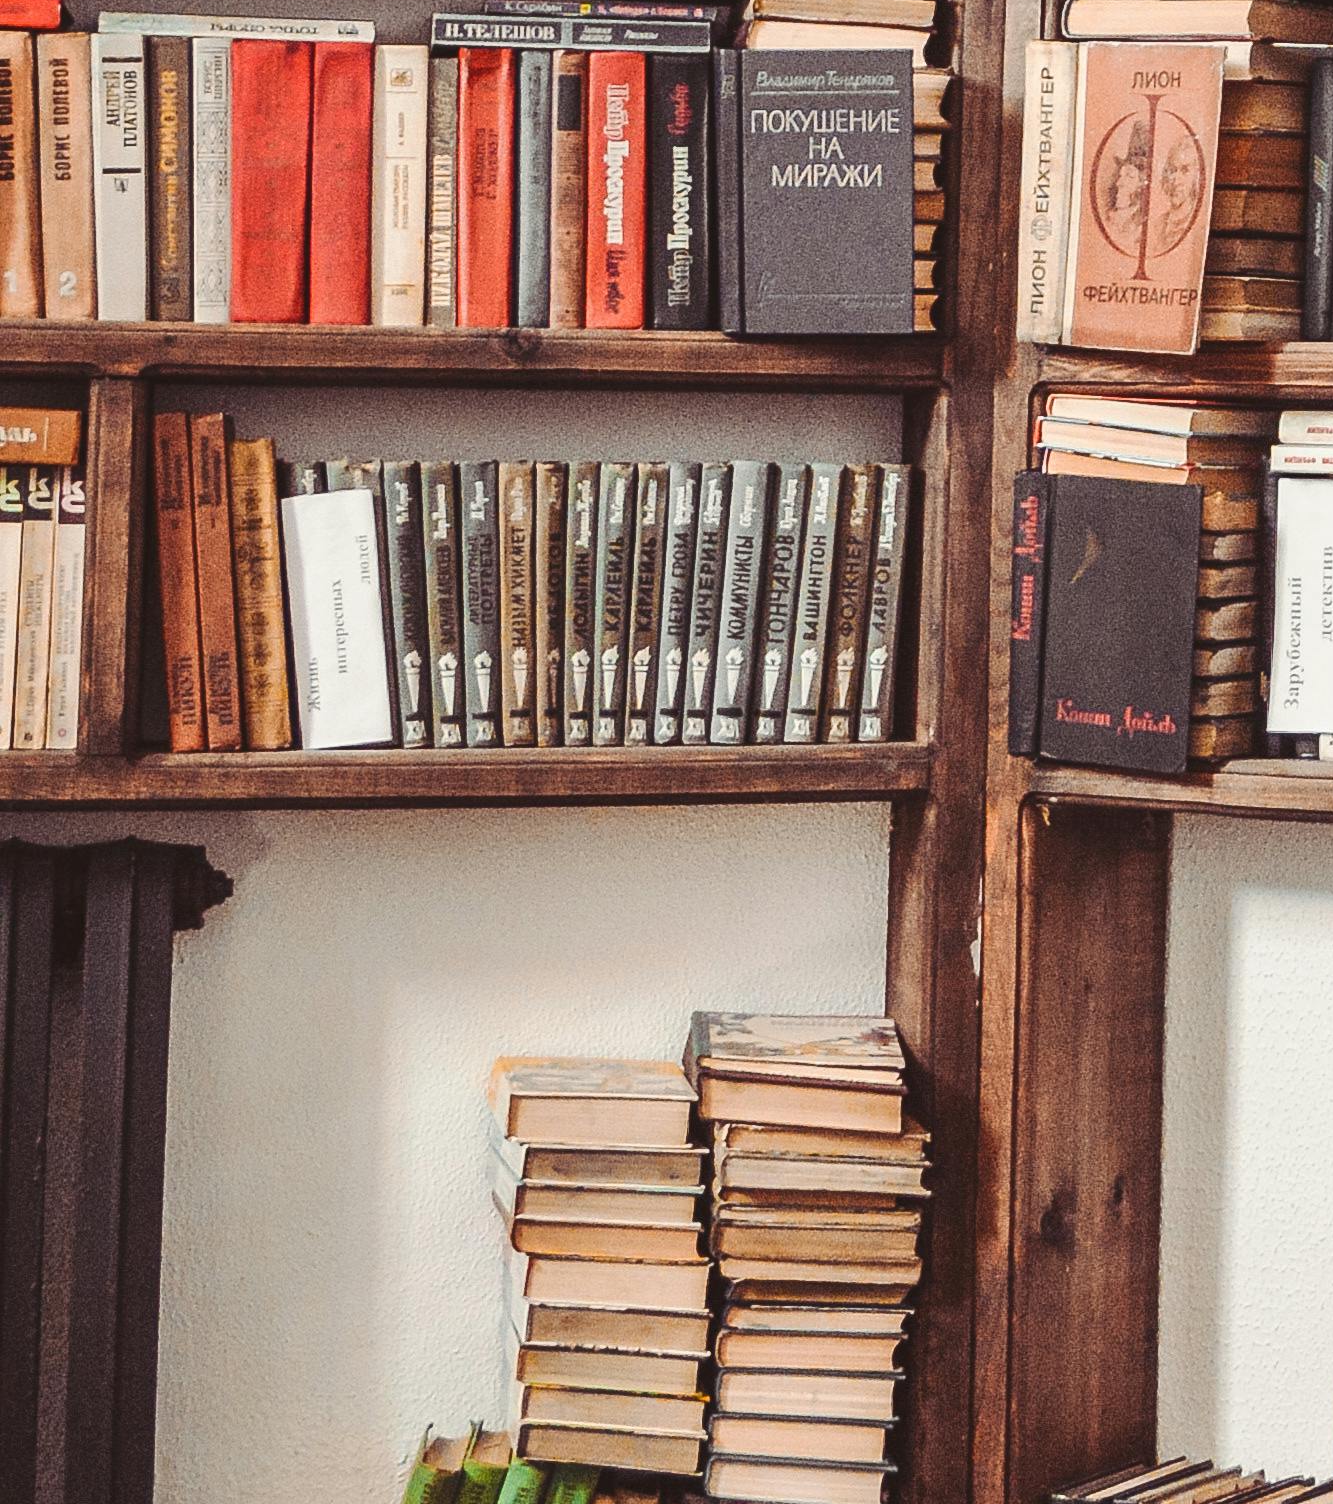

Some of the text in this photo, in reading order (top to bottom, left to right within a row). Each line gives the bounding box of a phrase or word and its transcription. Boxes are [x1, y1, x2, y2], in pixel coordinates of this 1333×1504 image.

[49, 58, 71, 181] БОРИС ПОЛЕВОЙ
[103, 71, 121, 127] АНДРЕЙ
[123, 70, 138, 147] ПЛАТОНОВ
[158, 69, 177, 173] СИМОНОВ
[749, 109, 901, 135] ПОКУШЕНИЕ
[756, 69, 896, 91] Владимир Тендряков
[1131, 70, 1182, 89] ЛИОН
[604, 139, 629, 246] Проскурин
[771, 163, 884, 189] МИРАЖИ
[807, 135, 845, 162] НА
[1030, 66, 1054, 316] ЛИОН ФЕЙХТВАНГЕР
[667, 145, 693, 249] Проскурин
[58, 271, 77, 297] 2
[1082, 285, 1198, 307] ФЕЙХТВАНГЕР
[356, 533, 372, 584] людей
[468, 535, 481, 626] ЛИТЕРАТУРНЫЕ
[479, 533, 494, 625] ПОРТРЕТЫ
[510, 526, 528, 647] НАЗЫМ ХИКМЕТ
[572, 551, 590, 641] ЛОДЫГИН
[667, 531, 689, 636] ПЕТРУ ГРОЗА
[695, 530, 719, 637] ЧИЧЕРИН
[726, 535, 754, 641] КОММУНИСТЫ
[767, 535, 795, 644] ГОНЧАРОВ
[803, 534, 827, 641] ВАШИНГТОН
[840, 536, 860, 637] ФОЛКНЕР
[872, 557, 890, 634] ЛАВРОВ
[331, 578, 350, 674] интересных
[1283, 576, 1304, 710] Зарубежный
[306, 656, 322, 713] Жизнь
[1055, 699, 1177, 737] Конан Дойль
